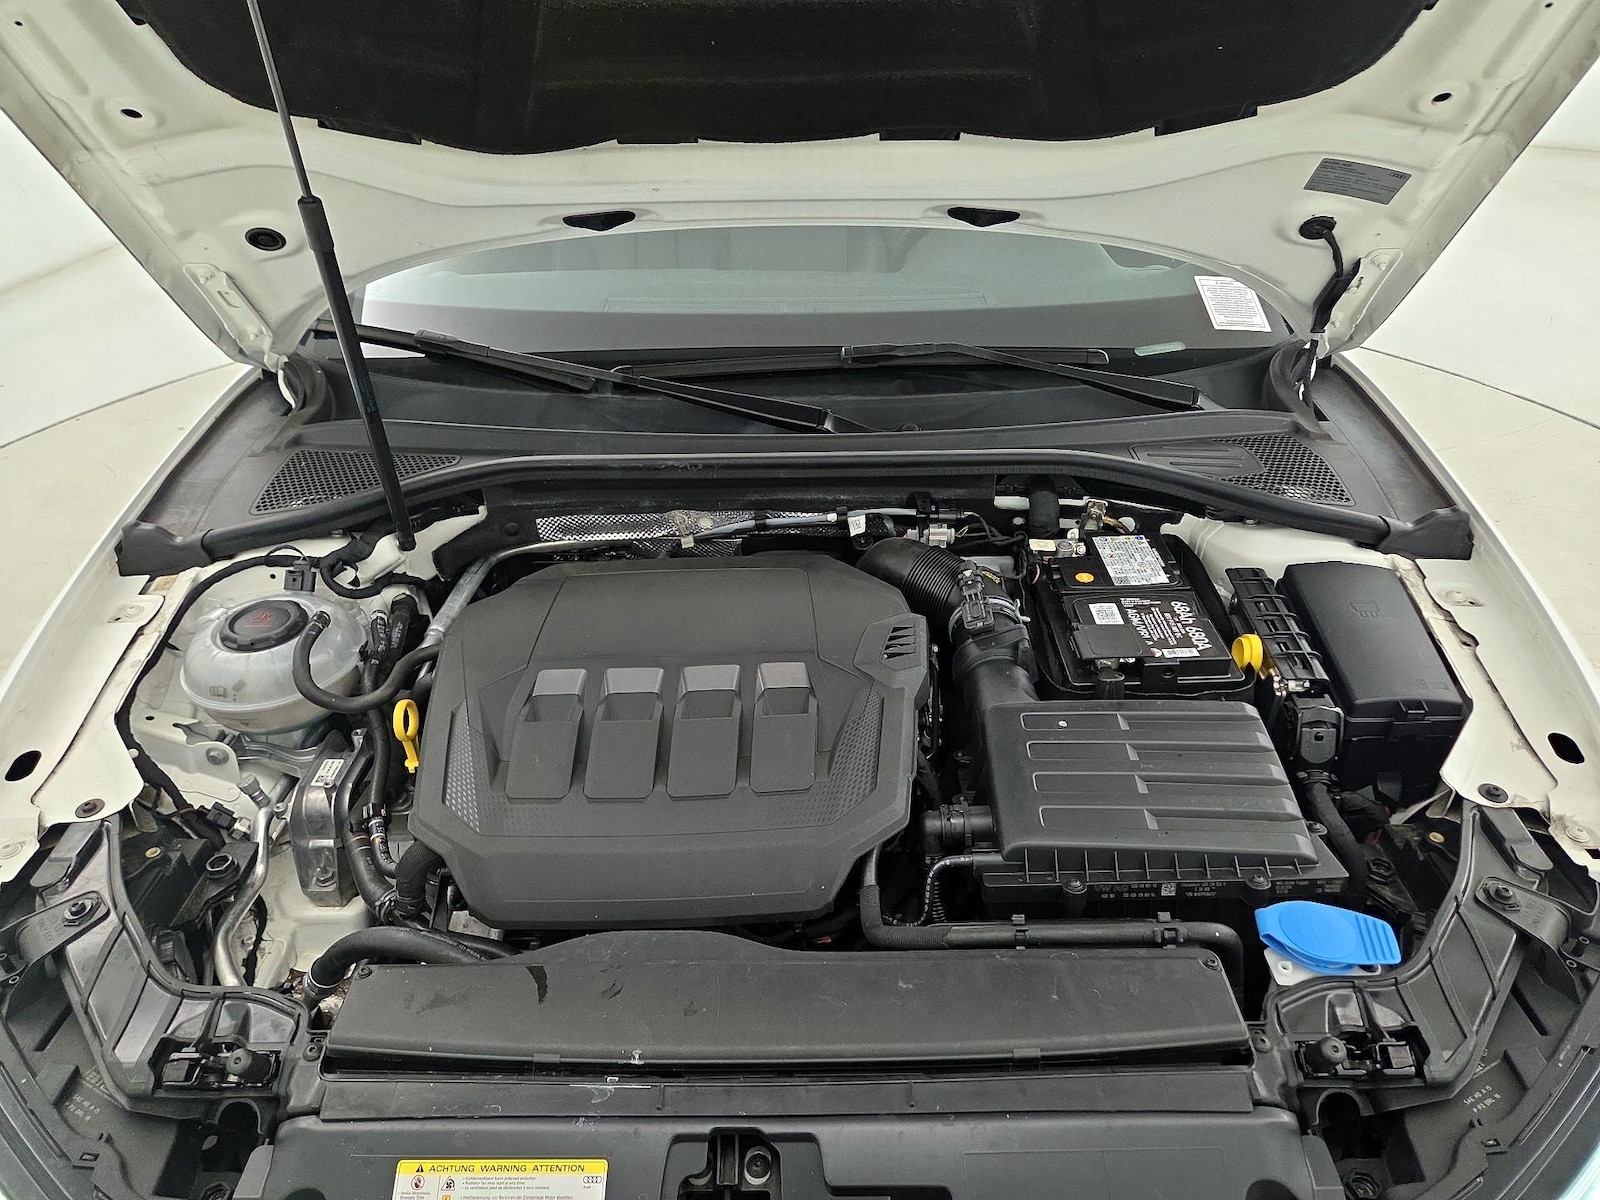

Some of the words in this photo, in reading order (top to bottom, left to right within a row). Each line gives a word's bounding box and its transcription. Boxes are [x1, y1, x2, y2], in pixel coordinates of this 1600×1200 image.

[1170, 600, 1197, 625] 68Ah
[1185, 625, 1213, 651] 680A
[428, 1164, 475, 1173] ACHTUNG
[480, 1164, 527, 1172] WARNING
[532, 1164, 585, 1172] ATTENTION
